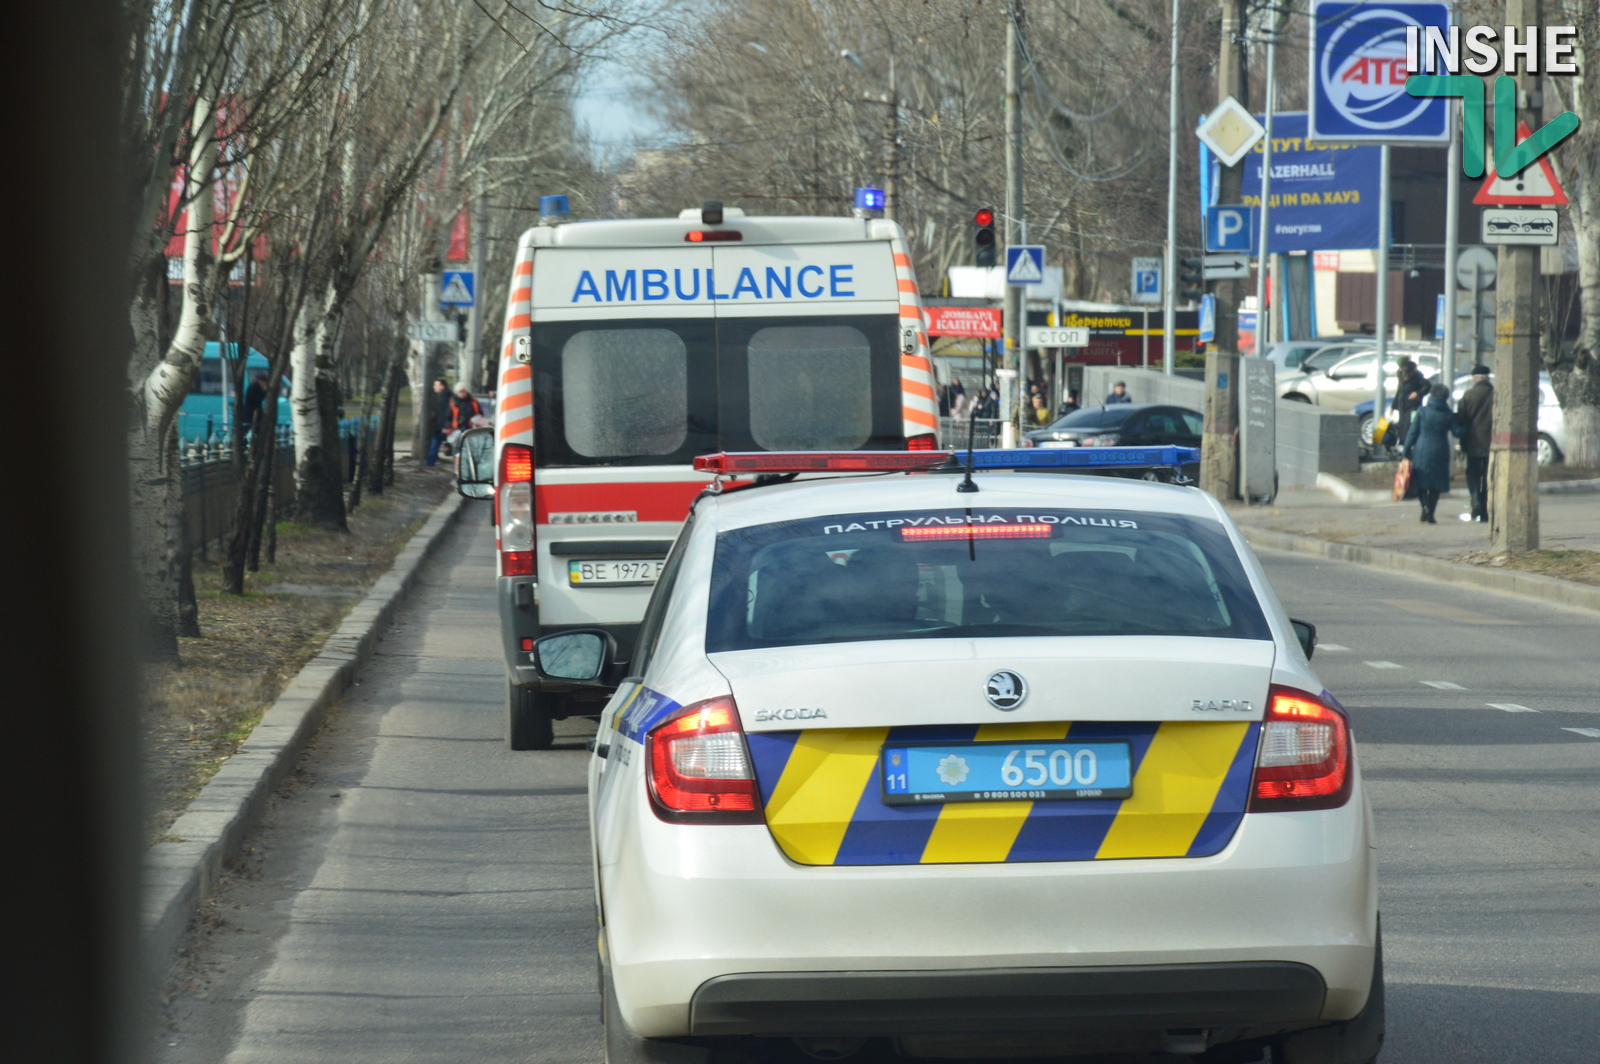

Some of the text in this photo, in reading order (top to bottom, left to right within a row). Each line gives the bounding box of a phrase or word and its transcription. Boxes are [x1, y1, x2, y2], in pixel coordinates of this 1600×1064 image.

[571, 264, 856, 303] AMBULANCE
[1038, 332, 1079, 343] СТОП
[823, 514, 1138, 535] ПАТРУЛЬНА ПОЛІЦІЯ
[582, 563, 607, 580] BE
[613, 563, 650, 579] 1972
[1191, 699, 1253, 712] RAPID
[1001, 749, 1097, 787] 6500
[887, 774, 906, 790] 11
